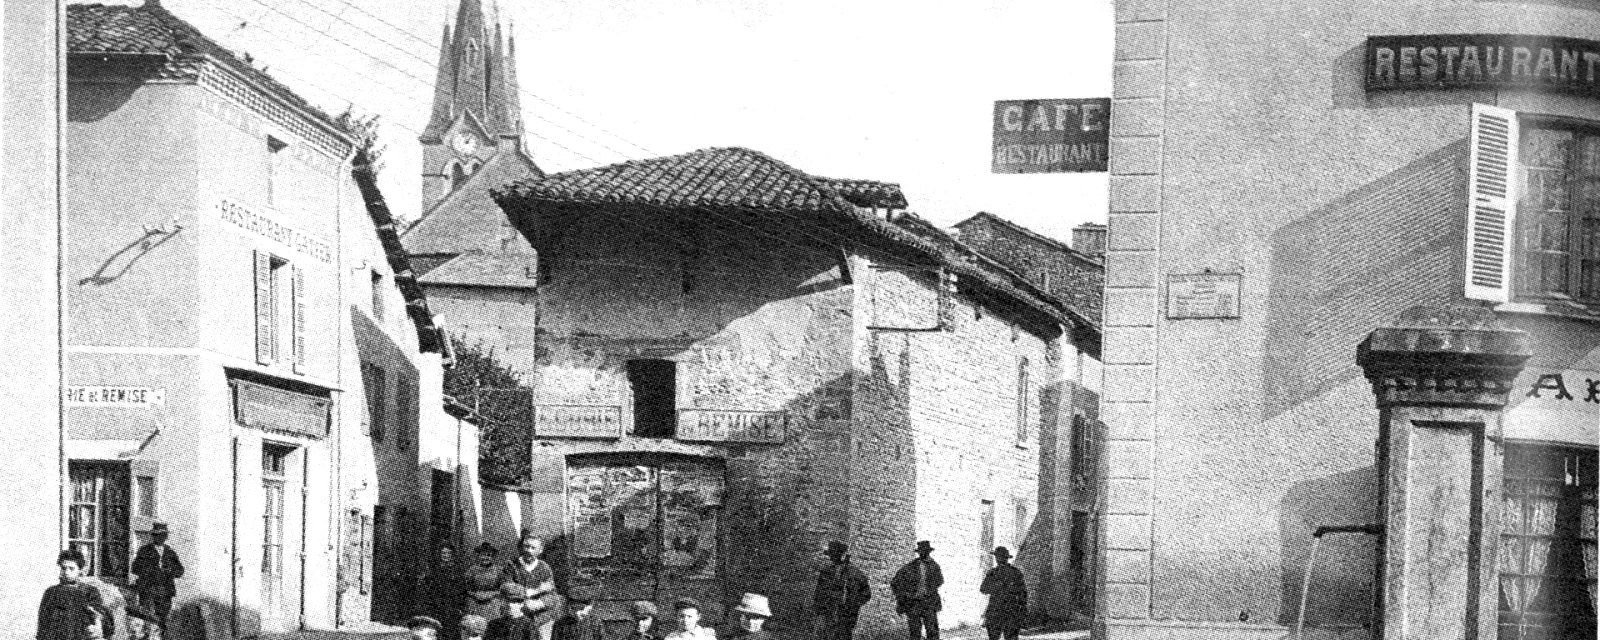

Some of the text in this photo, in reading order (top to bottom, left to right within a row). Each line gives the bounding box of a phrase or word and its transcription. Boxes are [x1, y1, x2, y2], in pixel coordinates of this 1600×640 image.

[1375, 46, 1600, 81] RESTAURANT
[996, 144, 1102, 165] RESTAURANT
[221, 199, 292, 247] RESTAURANT
[102, 388, 148, 403] REMISE
[698, 412, 780, 439] REMISE
